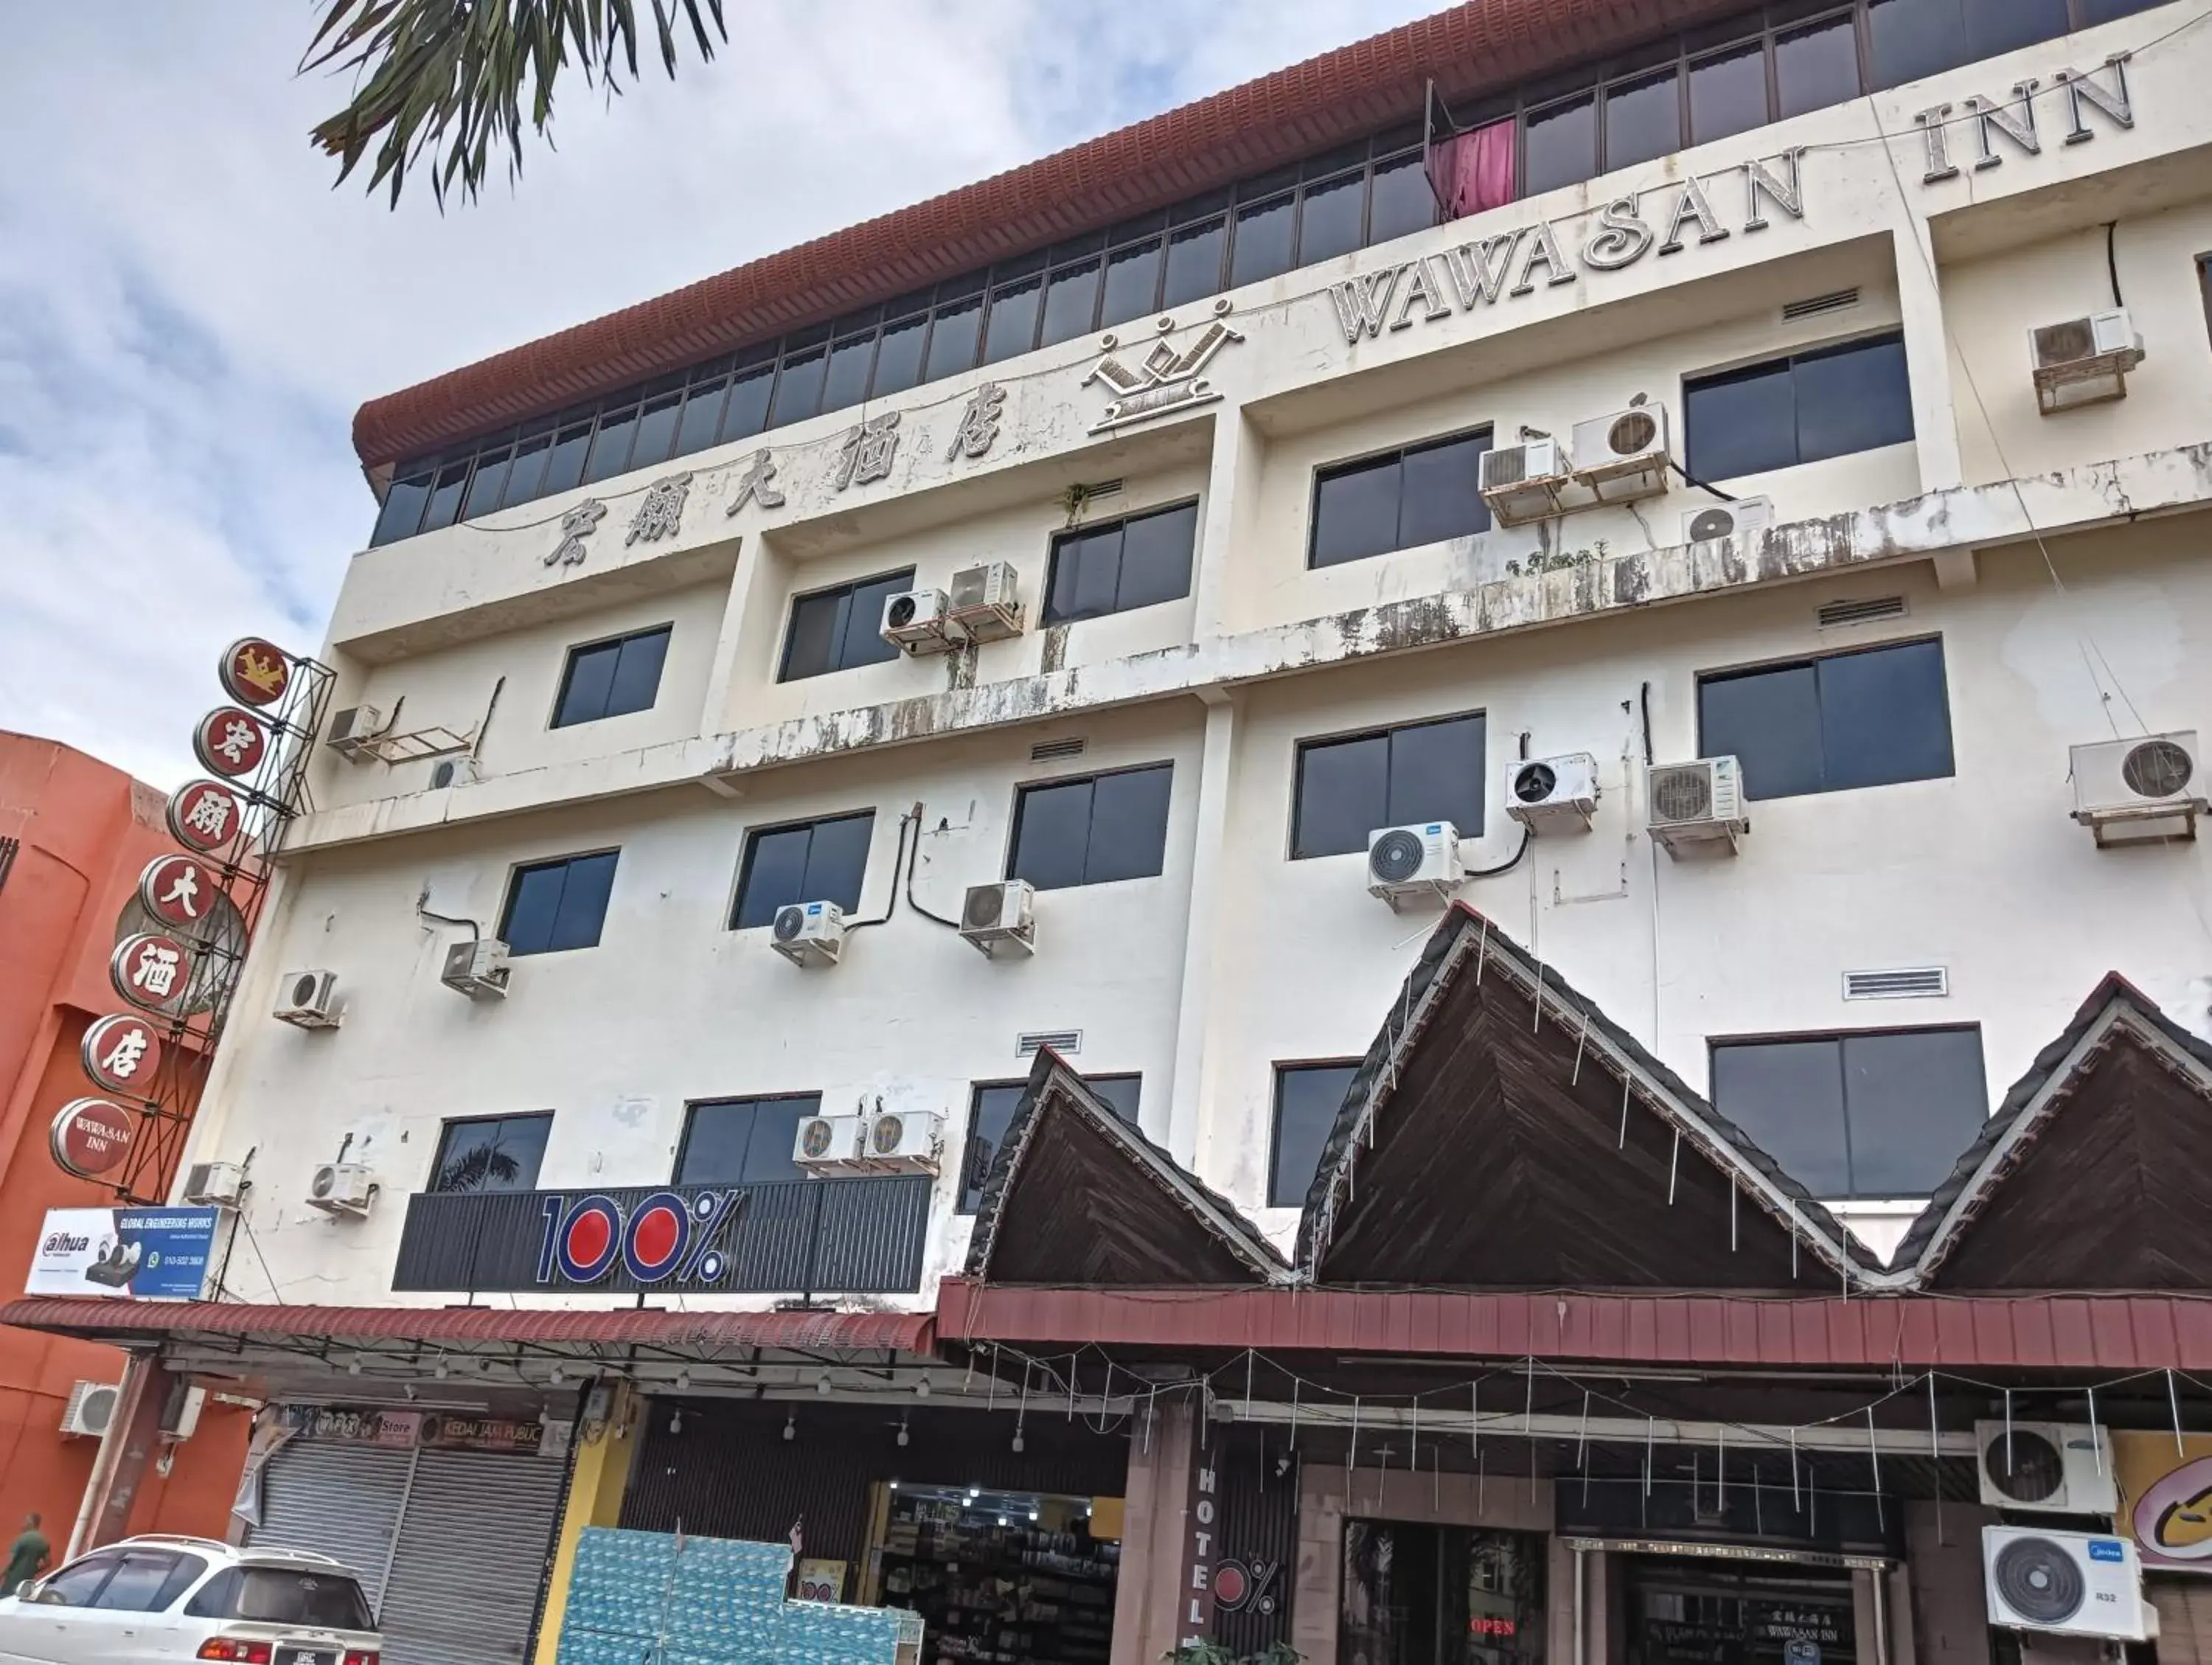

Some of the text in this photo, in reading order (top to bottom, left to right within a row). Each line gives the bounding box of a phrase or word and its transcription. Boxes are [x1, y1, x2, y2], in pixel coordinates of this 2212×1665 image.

[1328, 49, 2135, 344] WAWASAN INN
[76, 1115, 131, 1144] WAWASAN
[86, 1136, 109, 1153] INN
[120, 1217, 144, 1229] GLOBAL
[536, 1189, 743, 1284] 100%
[382, 1419, 411, 1433] Store
[445, 1421, 476, 1436] KEDAI
[1191, 1467, 1216, 1624] HOTEL
[2096, 1592, 2118, 1603] R32
[1470, 1619, 1516, 1636] OPEN
